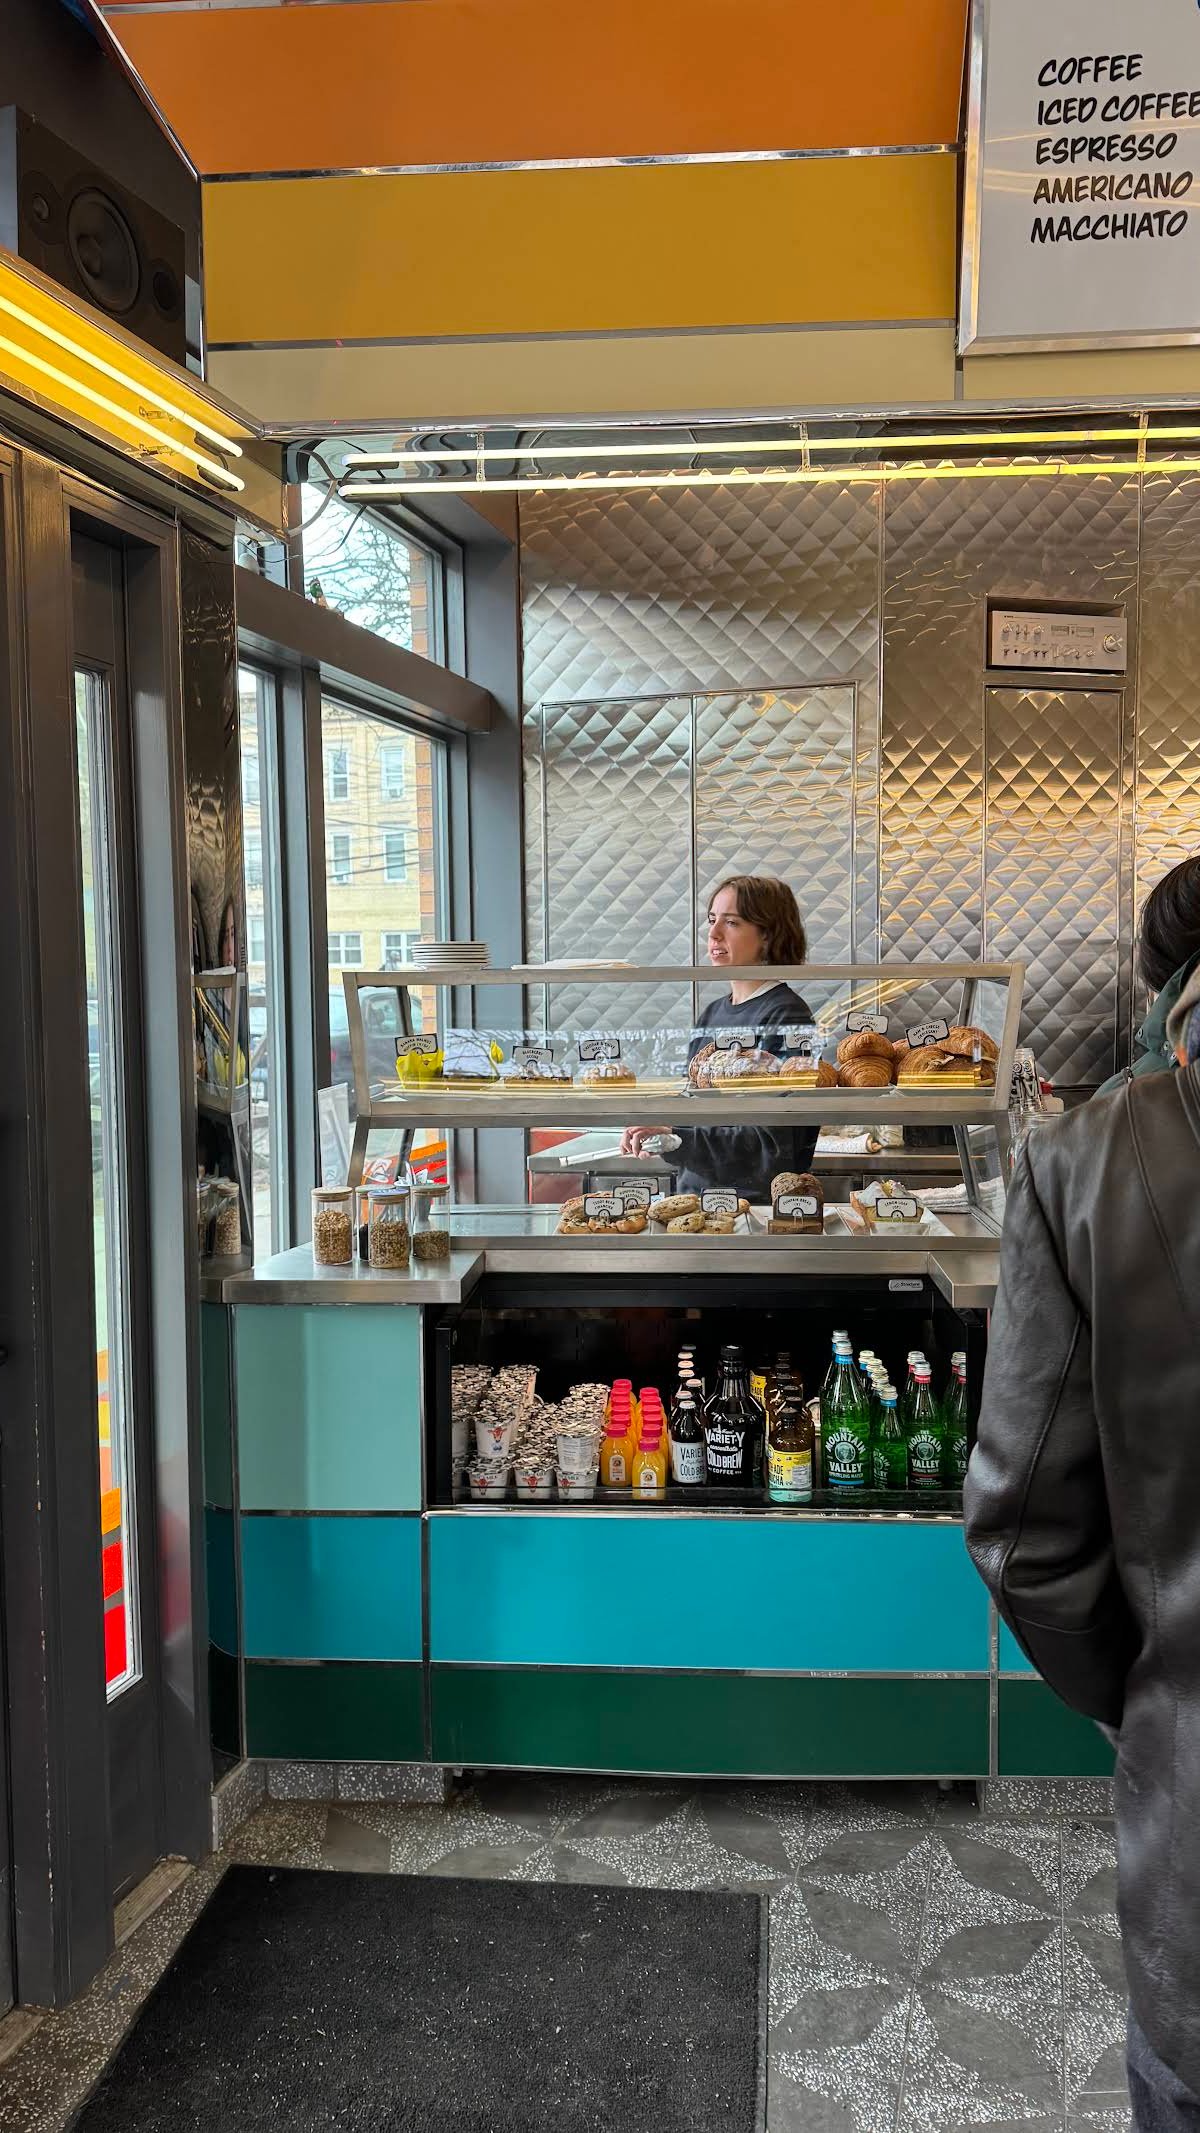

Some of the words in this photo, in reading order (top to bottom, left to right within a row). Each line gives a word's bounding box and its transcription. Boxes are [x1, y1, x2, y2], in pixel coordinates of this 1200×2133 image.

[1037, 54, 1143, 87] COFFEE
[1037, 97, 1097, 125] ICED
[1100, 91, 1200, 122] COFFEE
[1035, 132, 1178, 165] ESPRESSO
[1032, 170, 1194, 205] AMERICANO
[1030, 210, 1188, 243] MACCHIATO
[705, 1427, 745, 1448] VARIETY
[825, 1431, 866, 1455] MOUNTAIN
[908, 1434, 942, 1453] MOUNTAIN
[707, 1446, 722, 1468] COLD
[722, 1448, 743, 1469] BREW
[829, 1461, 863, 1474] VALLEY
[912, 1459, 940, 1469] VALLEY
[713, 1468, 734, 1476] COFFEE
